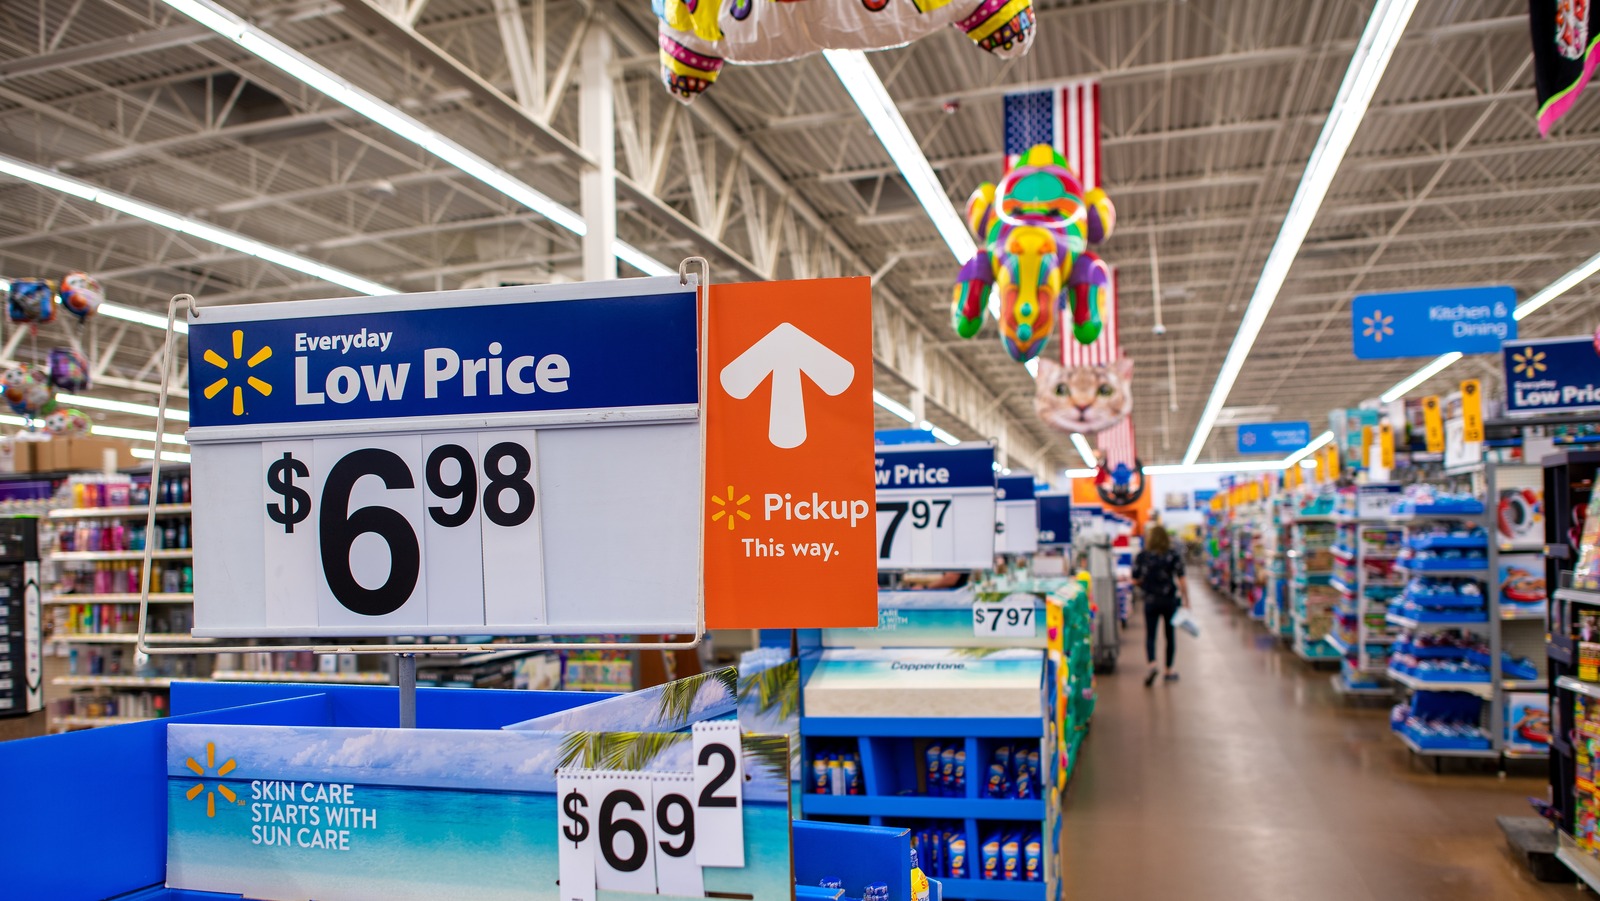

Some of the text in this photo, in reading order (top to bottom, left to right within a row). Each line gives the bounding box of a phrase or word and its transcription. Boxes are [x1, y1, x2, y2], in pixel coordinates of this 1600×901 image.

[1429, 301, 1508, 321] Kitchen &
[294, 328, 393, 354] Everyday
[1453, 320, 1508, 339] Dining
[294, 341, 571, 406] Low Price
[1514, 388, 1560, 407] Low
[894, 463, 950, 485] Price
[764, 492, 869, 528] Pickup
[266, 441, 536, 616] $698
[741, 538, 840, 562] This way.
[975, 607, 1034, 632] $797
[251, 780, 355, 805] SKIN CARE
[251, 802, 377, 829] STARTS WITH
[251, 824, 350, 850] SUN CARE
